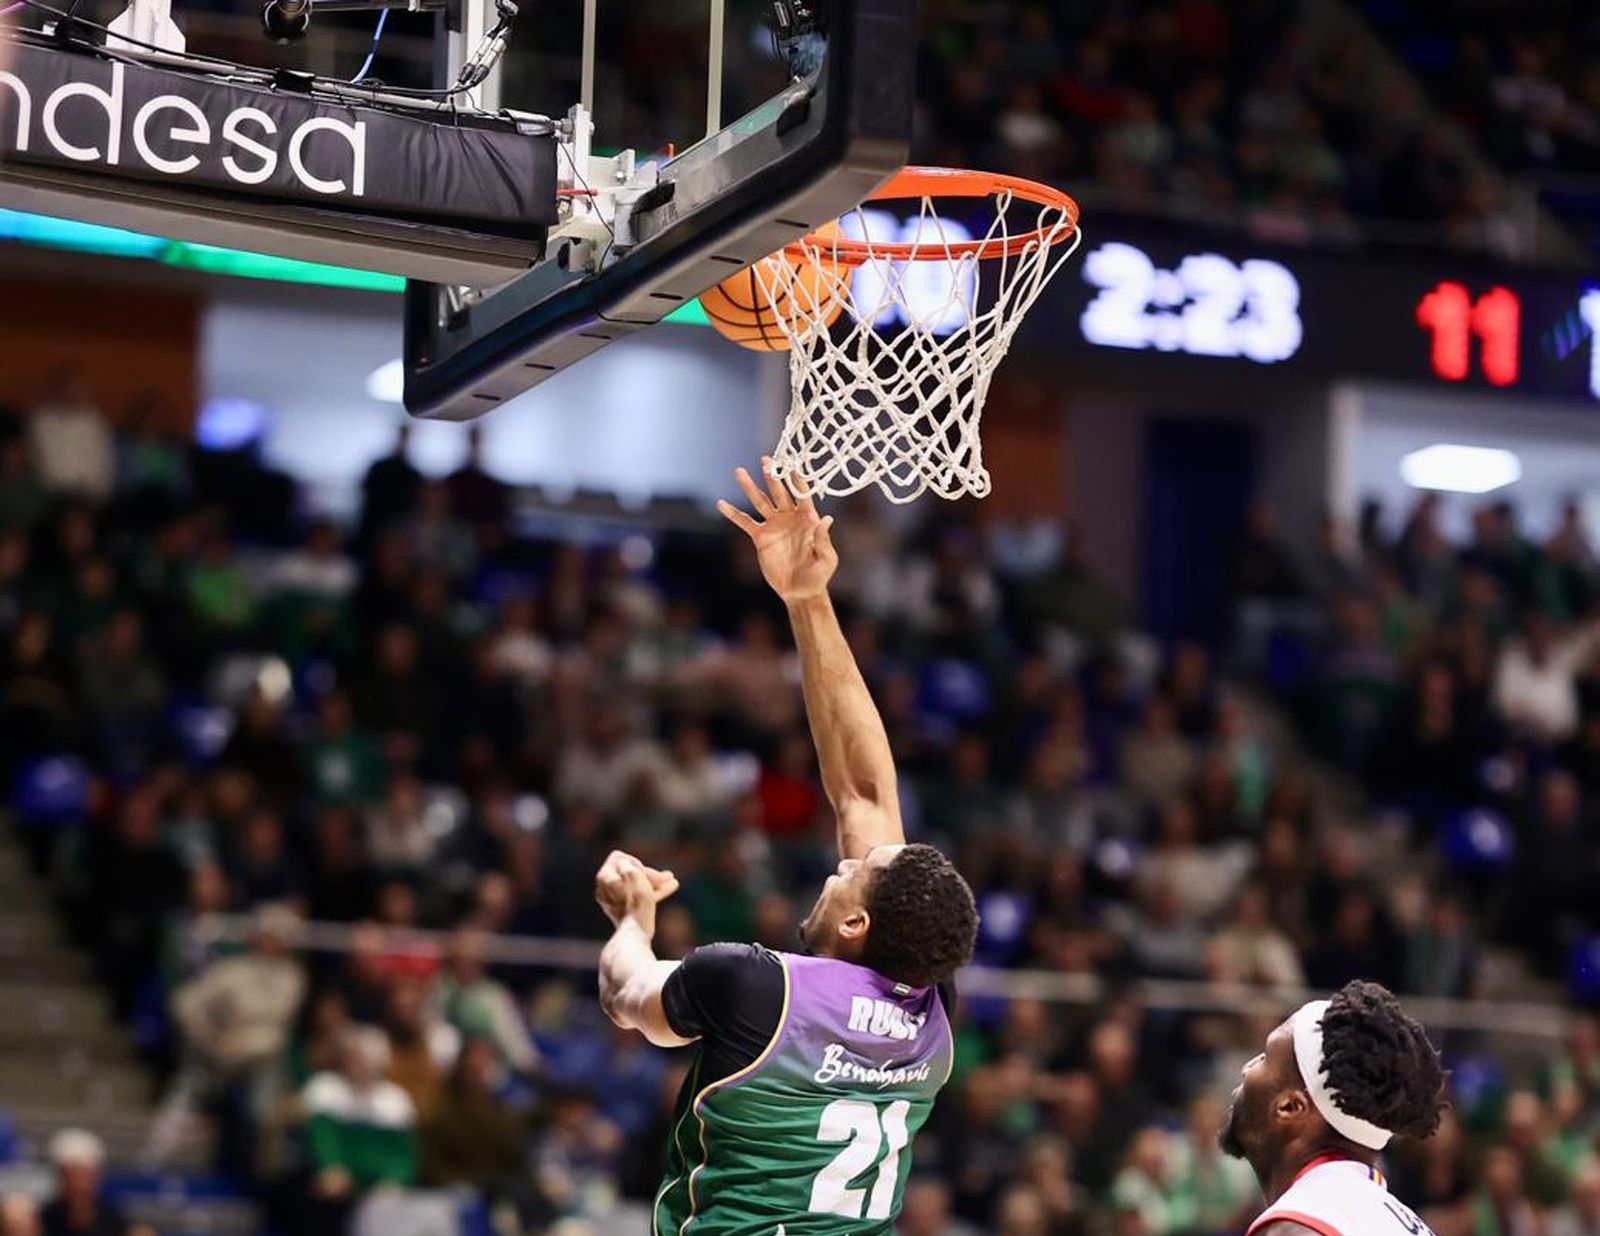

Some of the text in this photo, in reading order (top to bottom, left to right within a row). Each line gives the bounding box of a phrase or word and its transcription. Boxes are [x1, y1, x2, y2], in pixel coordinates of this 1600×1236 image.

[1081, 242, 1303, 364] 2:23
[1417, 281, 1520, 386] 11
[808, 1099, 911, 1219] 21
